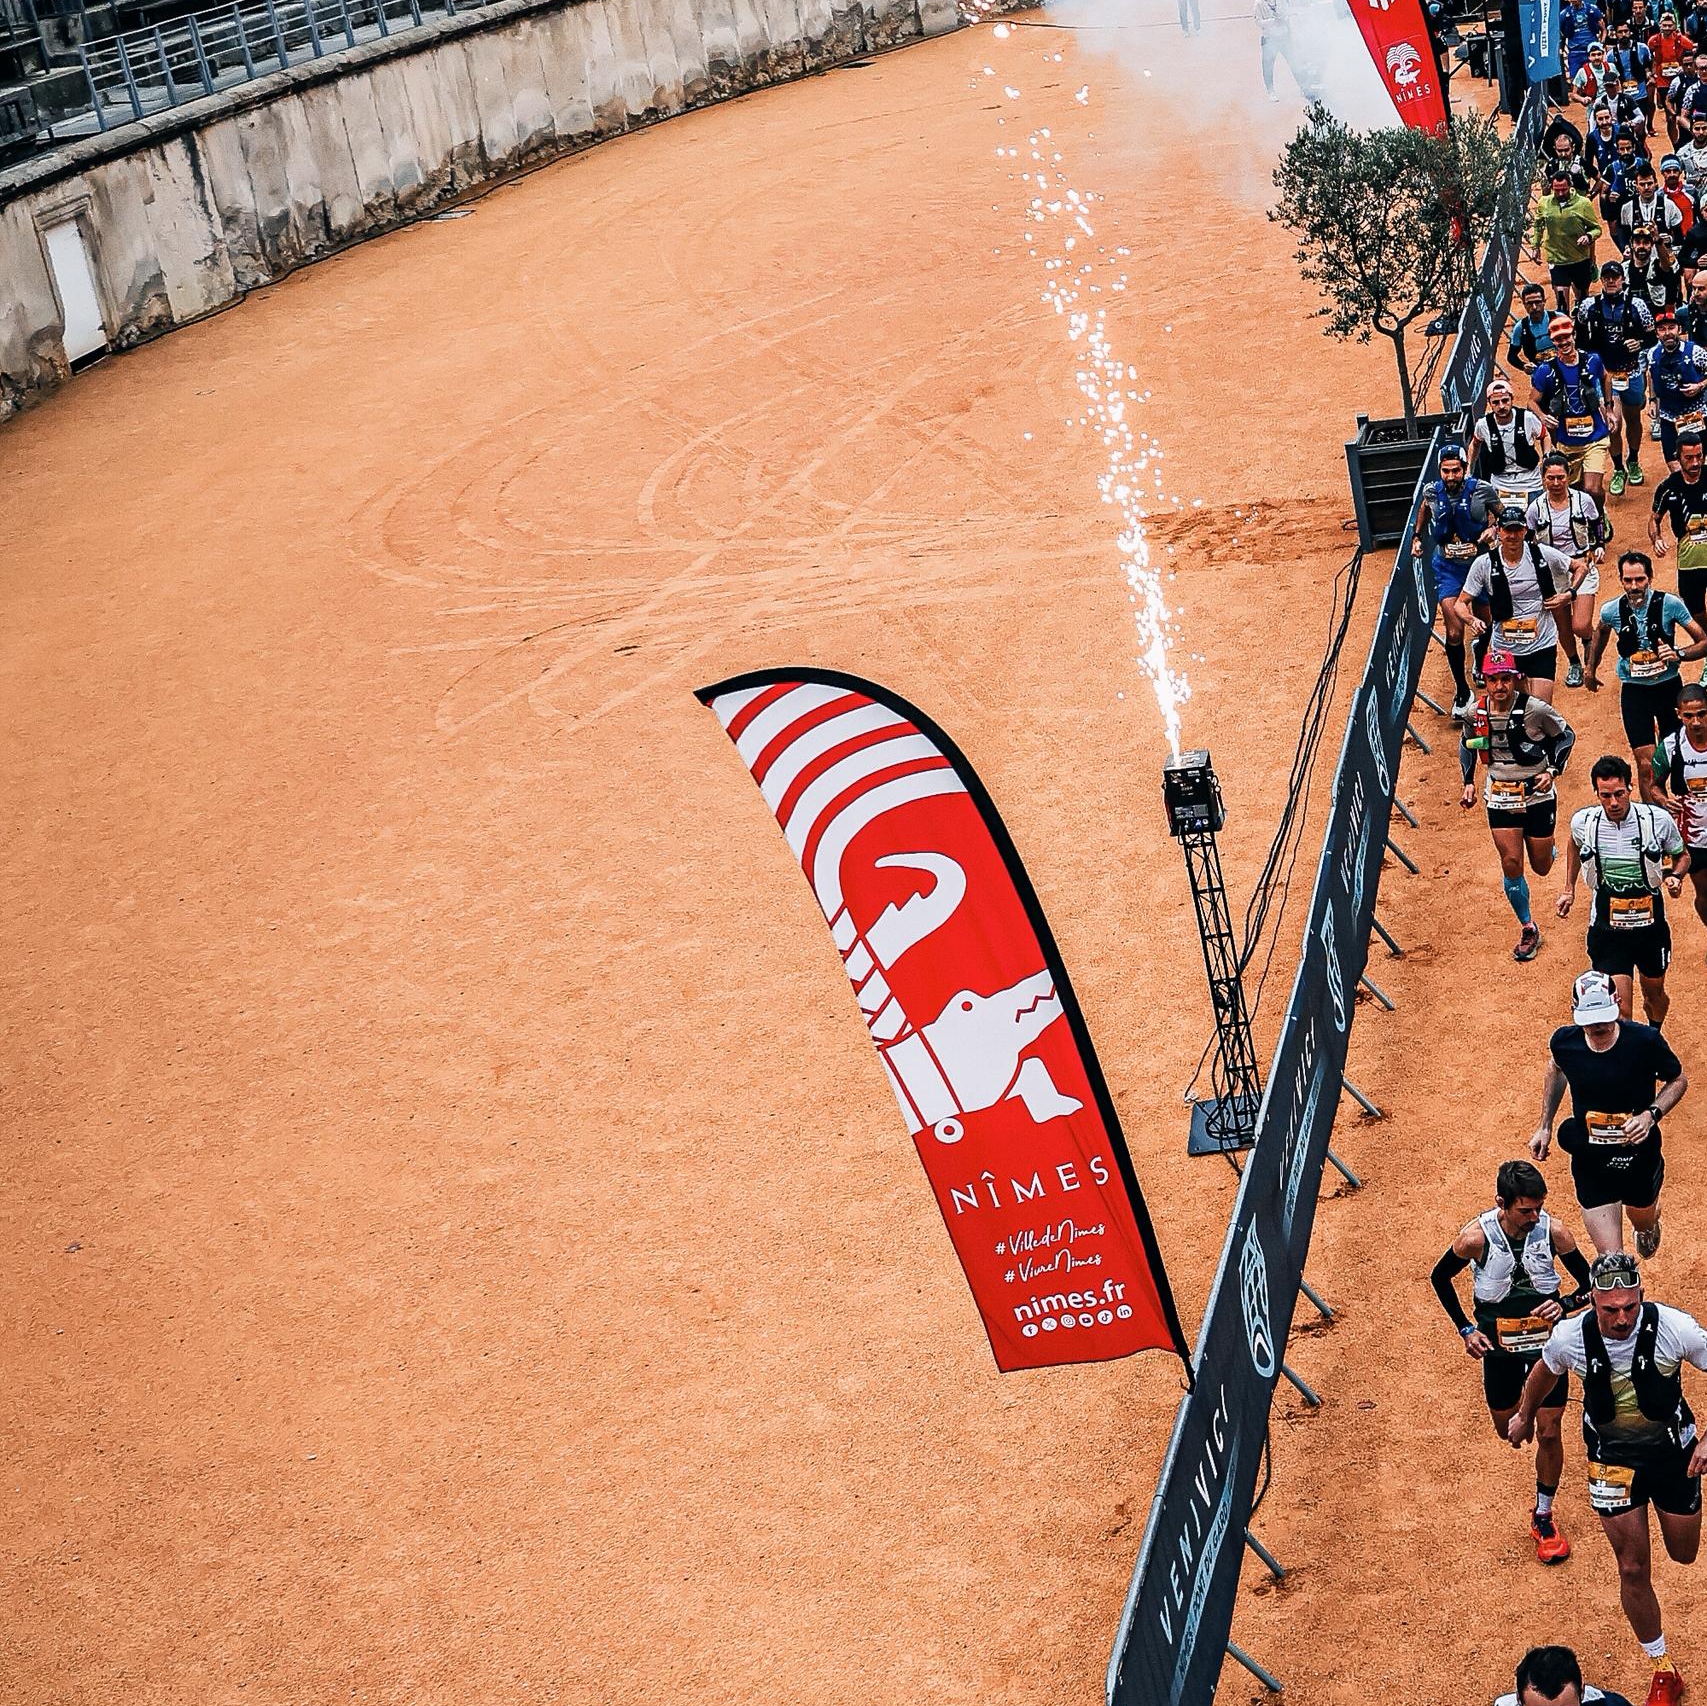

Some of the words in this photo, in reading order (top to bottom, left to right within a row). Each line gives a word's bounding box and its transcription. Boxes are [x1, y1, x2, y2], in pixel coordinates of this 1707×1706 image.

[950, 1156, 1109, 1215] NÎMES
[995, 1219, 1105, 1257] #VilledeNimes
[1013, 1279, 1126, 1322] nimes.fr
